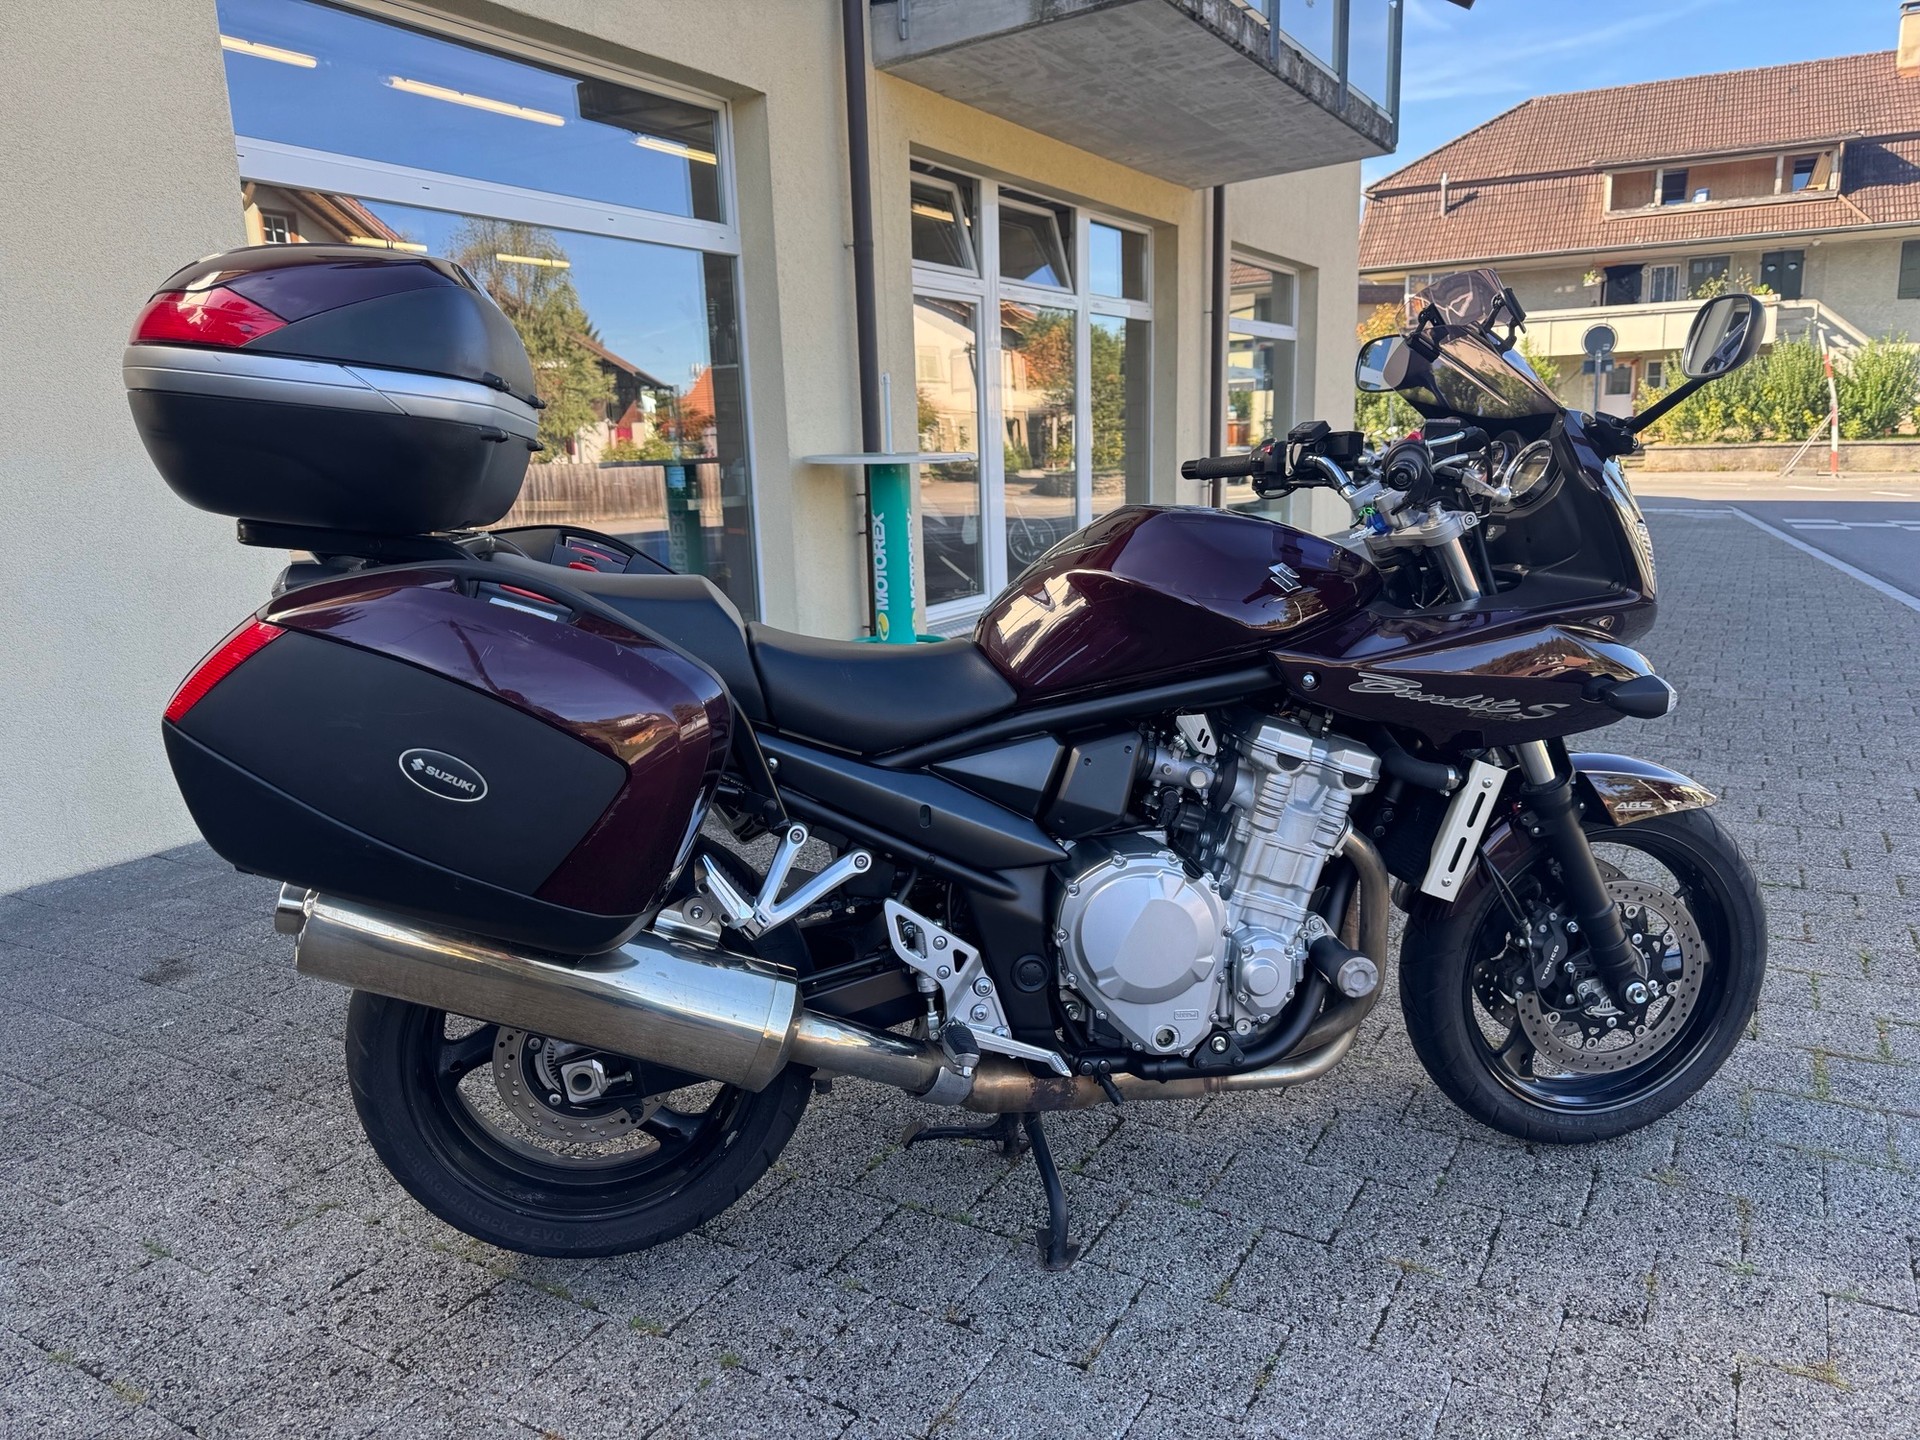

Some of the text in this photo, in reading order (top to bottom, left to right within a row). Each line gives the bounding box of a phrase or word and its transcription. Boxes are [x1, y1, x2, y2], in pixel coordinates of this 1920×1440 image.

[872, 512, 889, 610] MOTOREX
[1348, 672, 1521, 713] Bandit
[425, 765, 476, 792] SUZUKI
[1614, 801, 1654, 810] ABS
[1540, 944, 1560, 981] TOKICO
[527, 1229, 567, 1242] EVO
